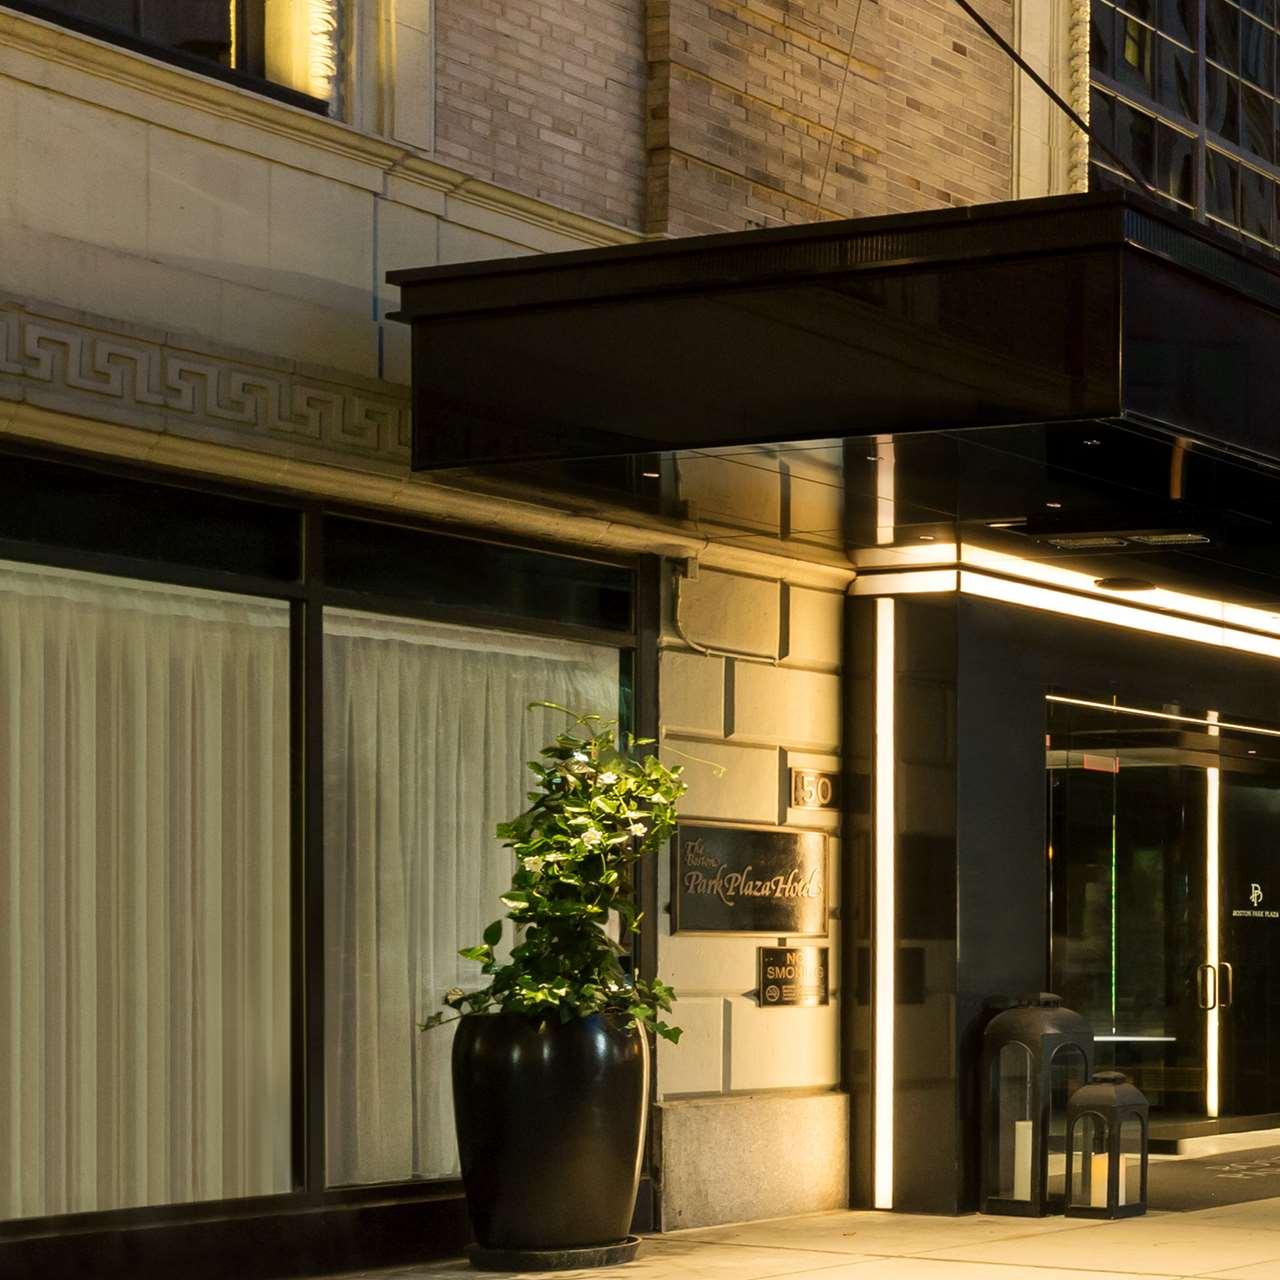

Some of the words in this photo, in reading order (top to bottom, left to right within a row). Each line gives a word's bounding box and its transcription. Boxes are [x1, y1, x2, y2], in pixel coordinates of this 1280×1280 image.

[801, 775, 832, 804] 50
[684, 837, 704, 854] The
[684, 864, 735, 907] Park
[724, 865, 772, 897] Plaza
[771, 868, 823, 898] Hotel
